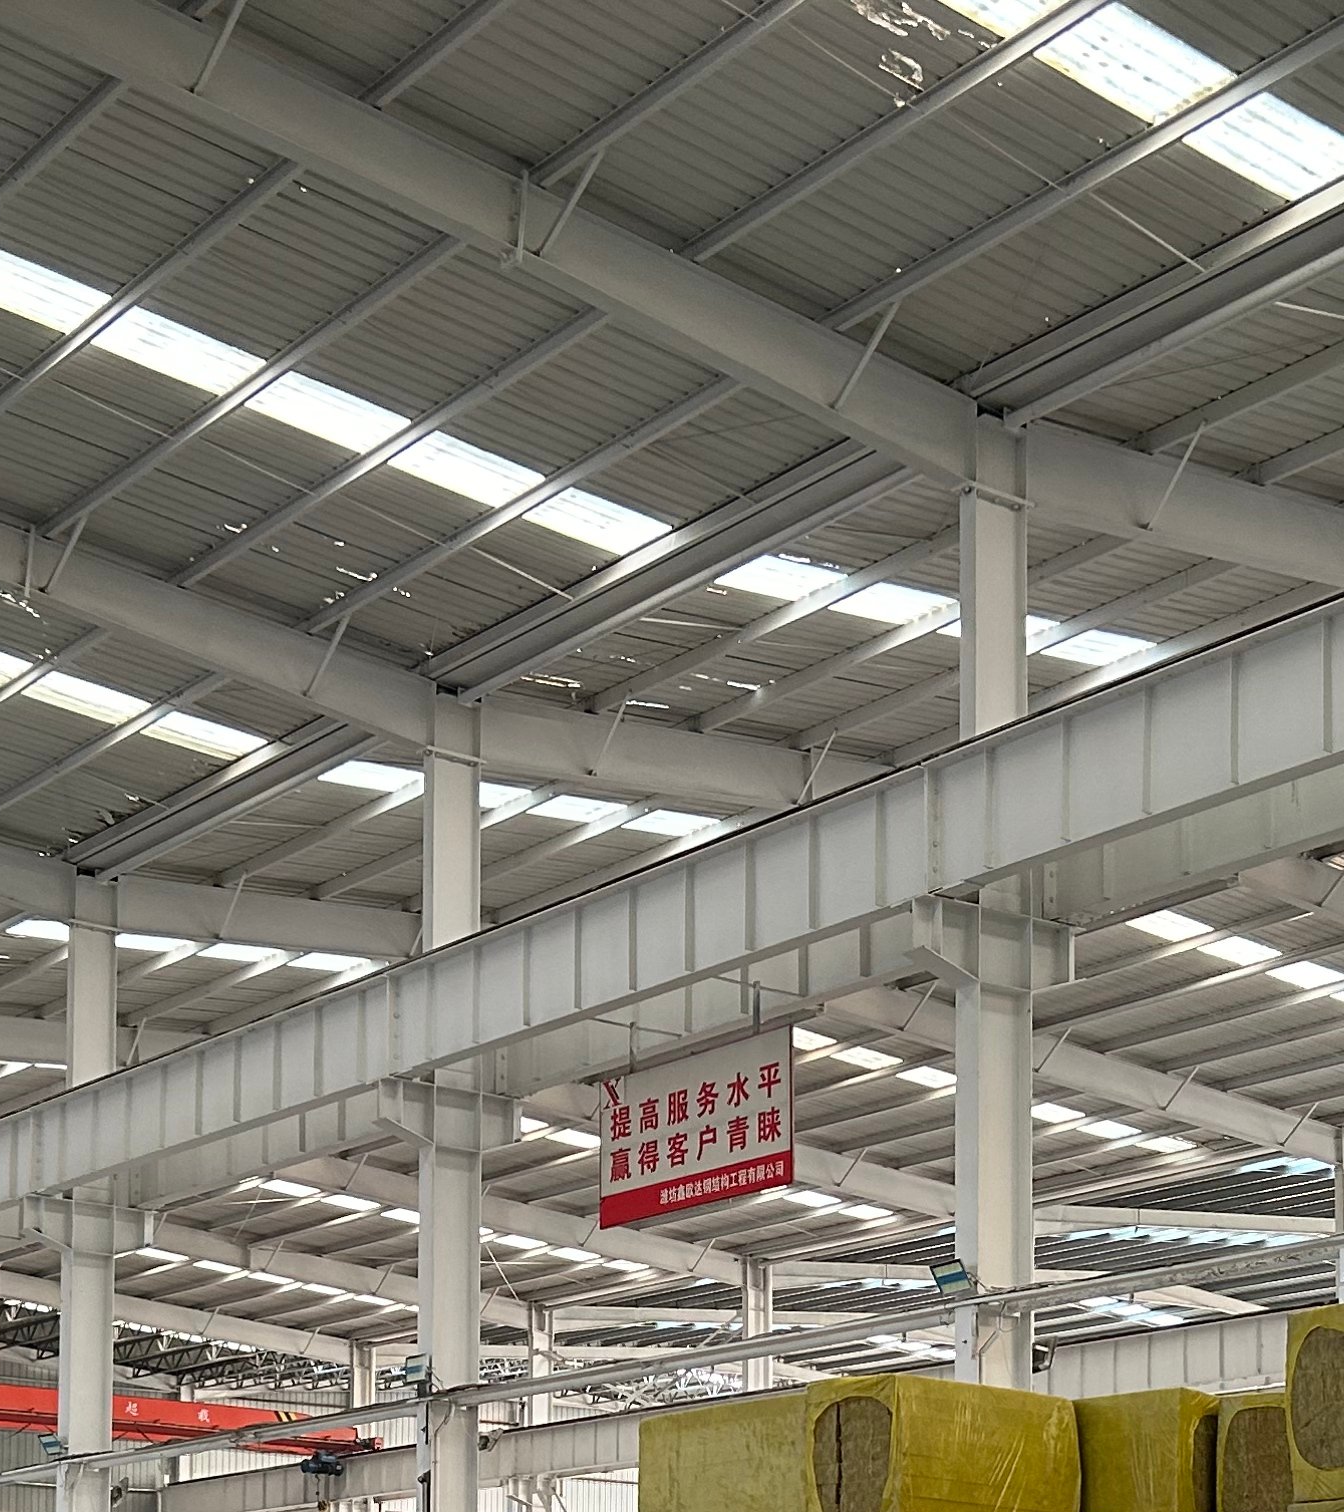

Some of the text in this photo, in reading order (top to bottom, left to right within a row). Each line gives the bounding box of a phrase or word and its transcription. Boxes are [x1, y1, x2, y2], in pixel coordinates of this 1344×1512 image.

[610, 1062, 782, 1141] 提高服务水平
[609, 1106, 782, 1183] 赢得客户青睐
[659, 1160, 785, 1205] 潍坊鑫欧达钢结构工程有限公司
